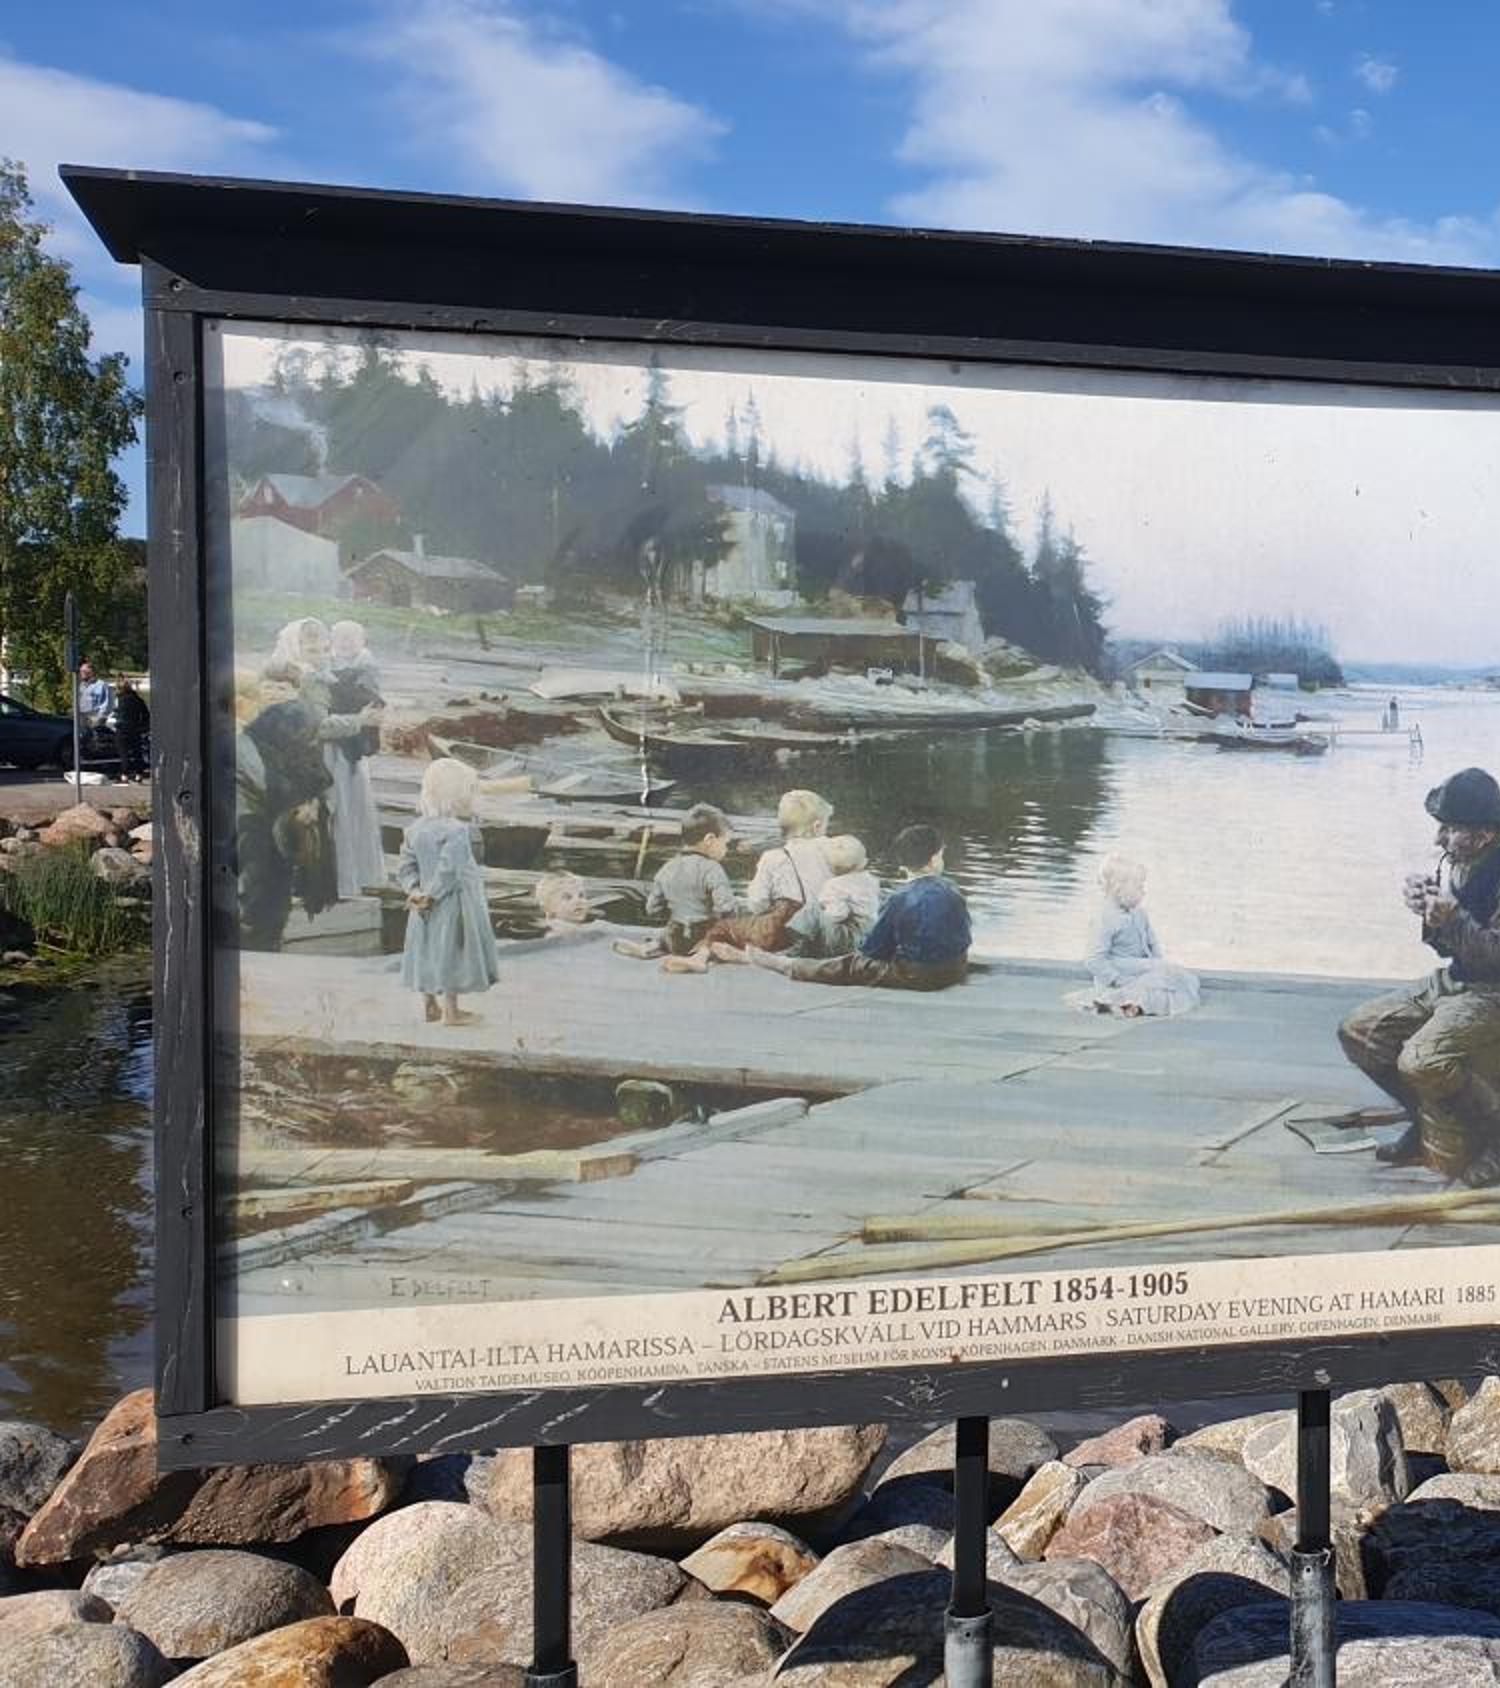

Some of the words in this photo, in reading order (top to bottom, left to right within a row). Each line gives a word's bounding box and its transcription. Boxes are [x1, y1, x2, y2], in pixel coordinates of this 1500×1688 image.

[718, 1290, 857, 1323] ALBERT
[867, 1279, 1042, 1315] EDELFELT
[1052, 1271, 1189, 1303] 1854-1905
[345, 1345, 539, 1375] LAUANTAI-ILTA
[547, 1336, 695, 1363] HAMARISSA
[721, 1321, 915, 1353] LÖRDAGSKVÄLL
[919, 1319, 961, 1340] VID
[969, 1311, 1088, 1337] HAMMARS
[1105, 1301, 1222, 1328] SATURDAY
[1229, 1294, 1324, 1319] EVENING
[1328, 1293, 1355, 1312] AT
[1359, 1287, 1445, 1310] HAMARI
[1457, 1284, 1496, 1304] 1885
[763, 1354, 818, 1370] STATENS
[822, 1351, 881, 1366] MUSEUM
[1053, 1335, 1117, 1351] DANMARK
[1127, 1331, 1174, 1345] DANISH
[1176, 1326, 1238, 1342] NATIONAL
